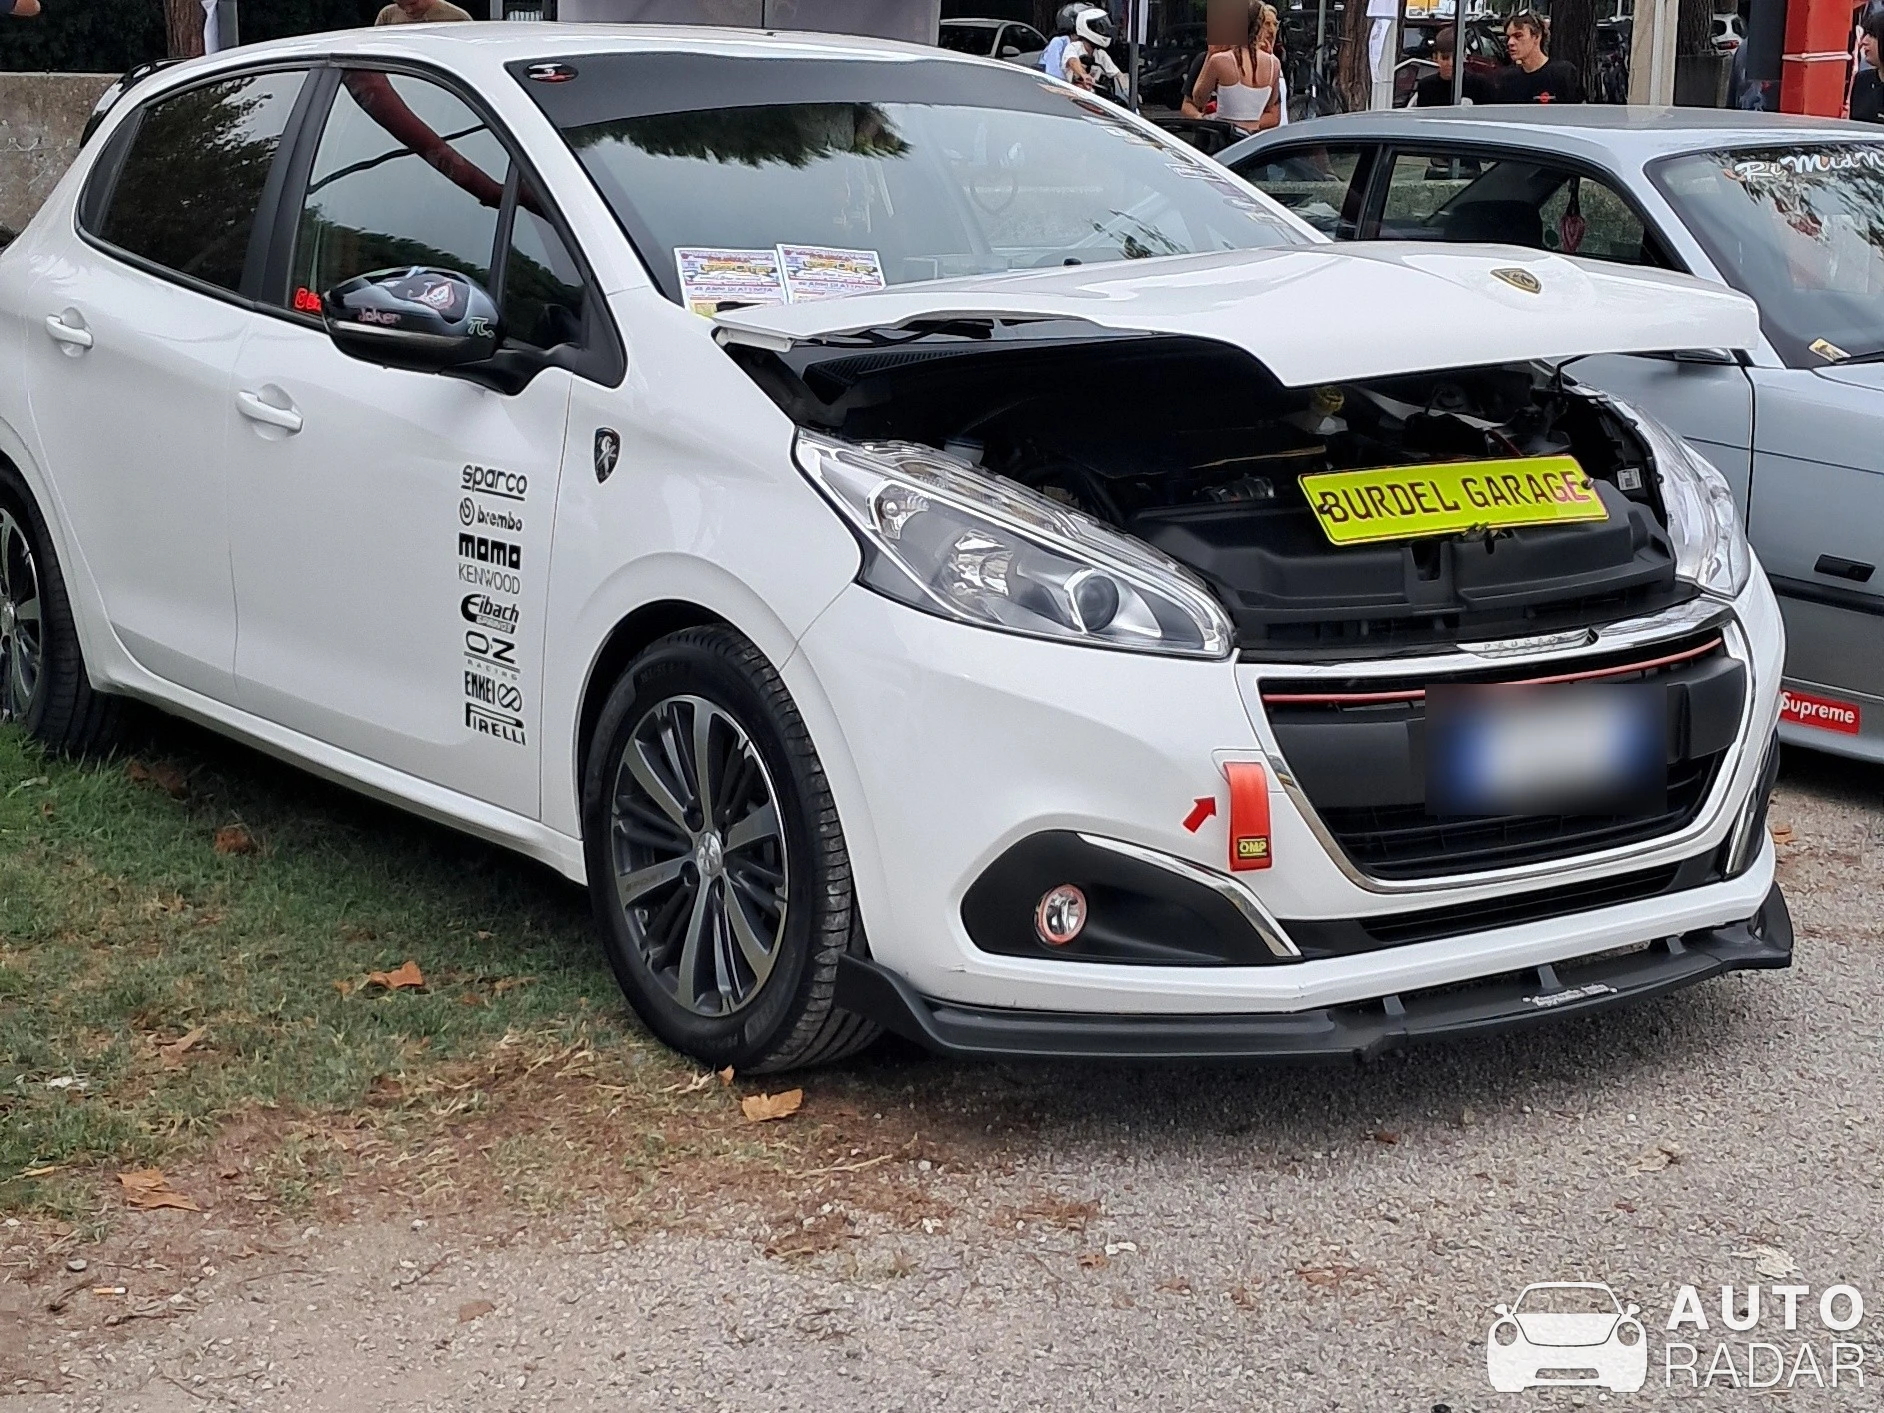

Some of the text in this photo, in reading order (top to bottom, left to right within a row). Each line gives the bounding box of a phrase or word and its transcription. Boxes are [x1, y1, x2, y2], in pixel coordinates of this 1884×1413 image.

[462, 464, 528, 495] sparco
[1318, 470, 1590, 524] BURDEL GARAGE
[477, 504, 523, 531] brembo
[458, 531, 522, 570] momo
[458, 562, 521, 595] KENWOOD
[460, 593, 520, 624] Eibach
[464, 670, 496, 705] ENKEI
[464, 701, 526, 746] PIRELLI
[1781, 691, 1856, 724] Supreme
[1239, 840, 1267, 853] OMP
